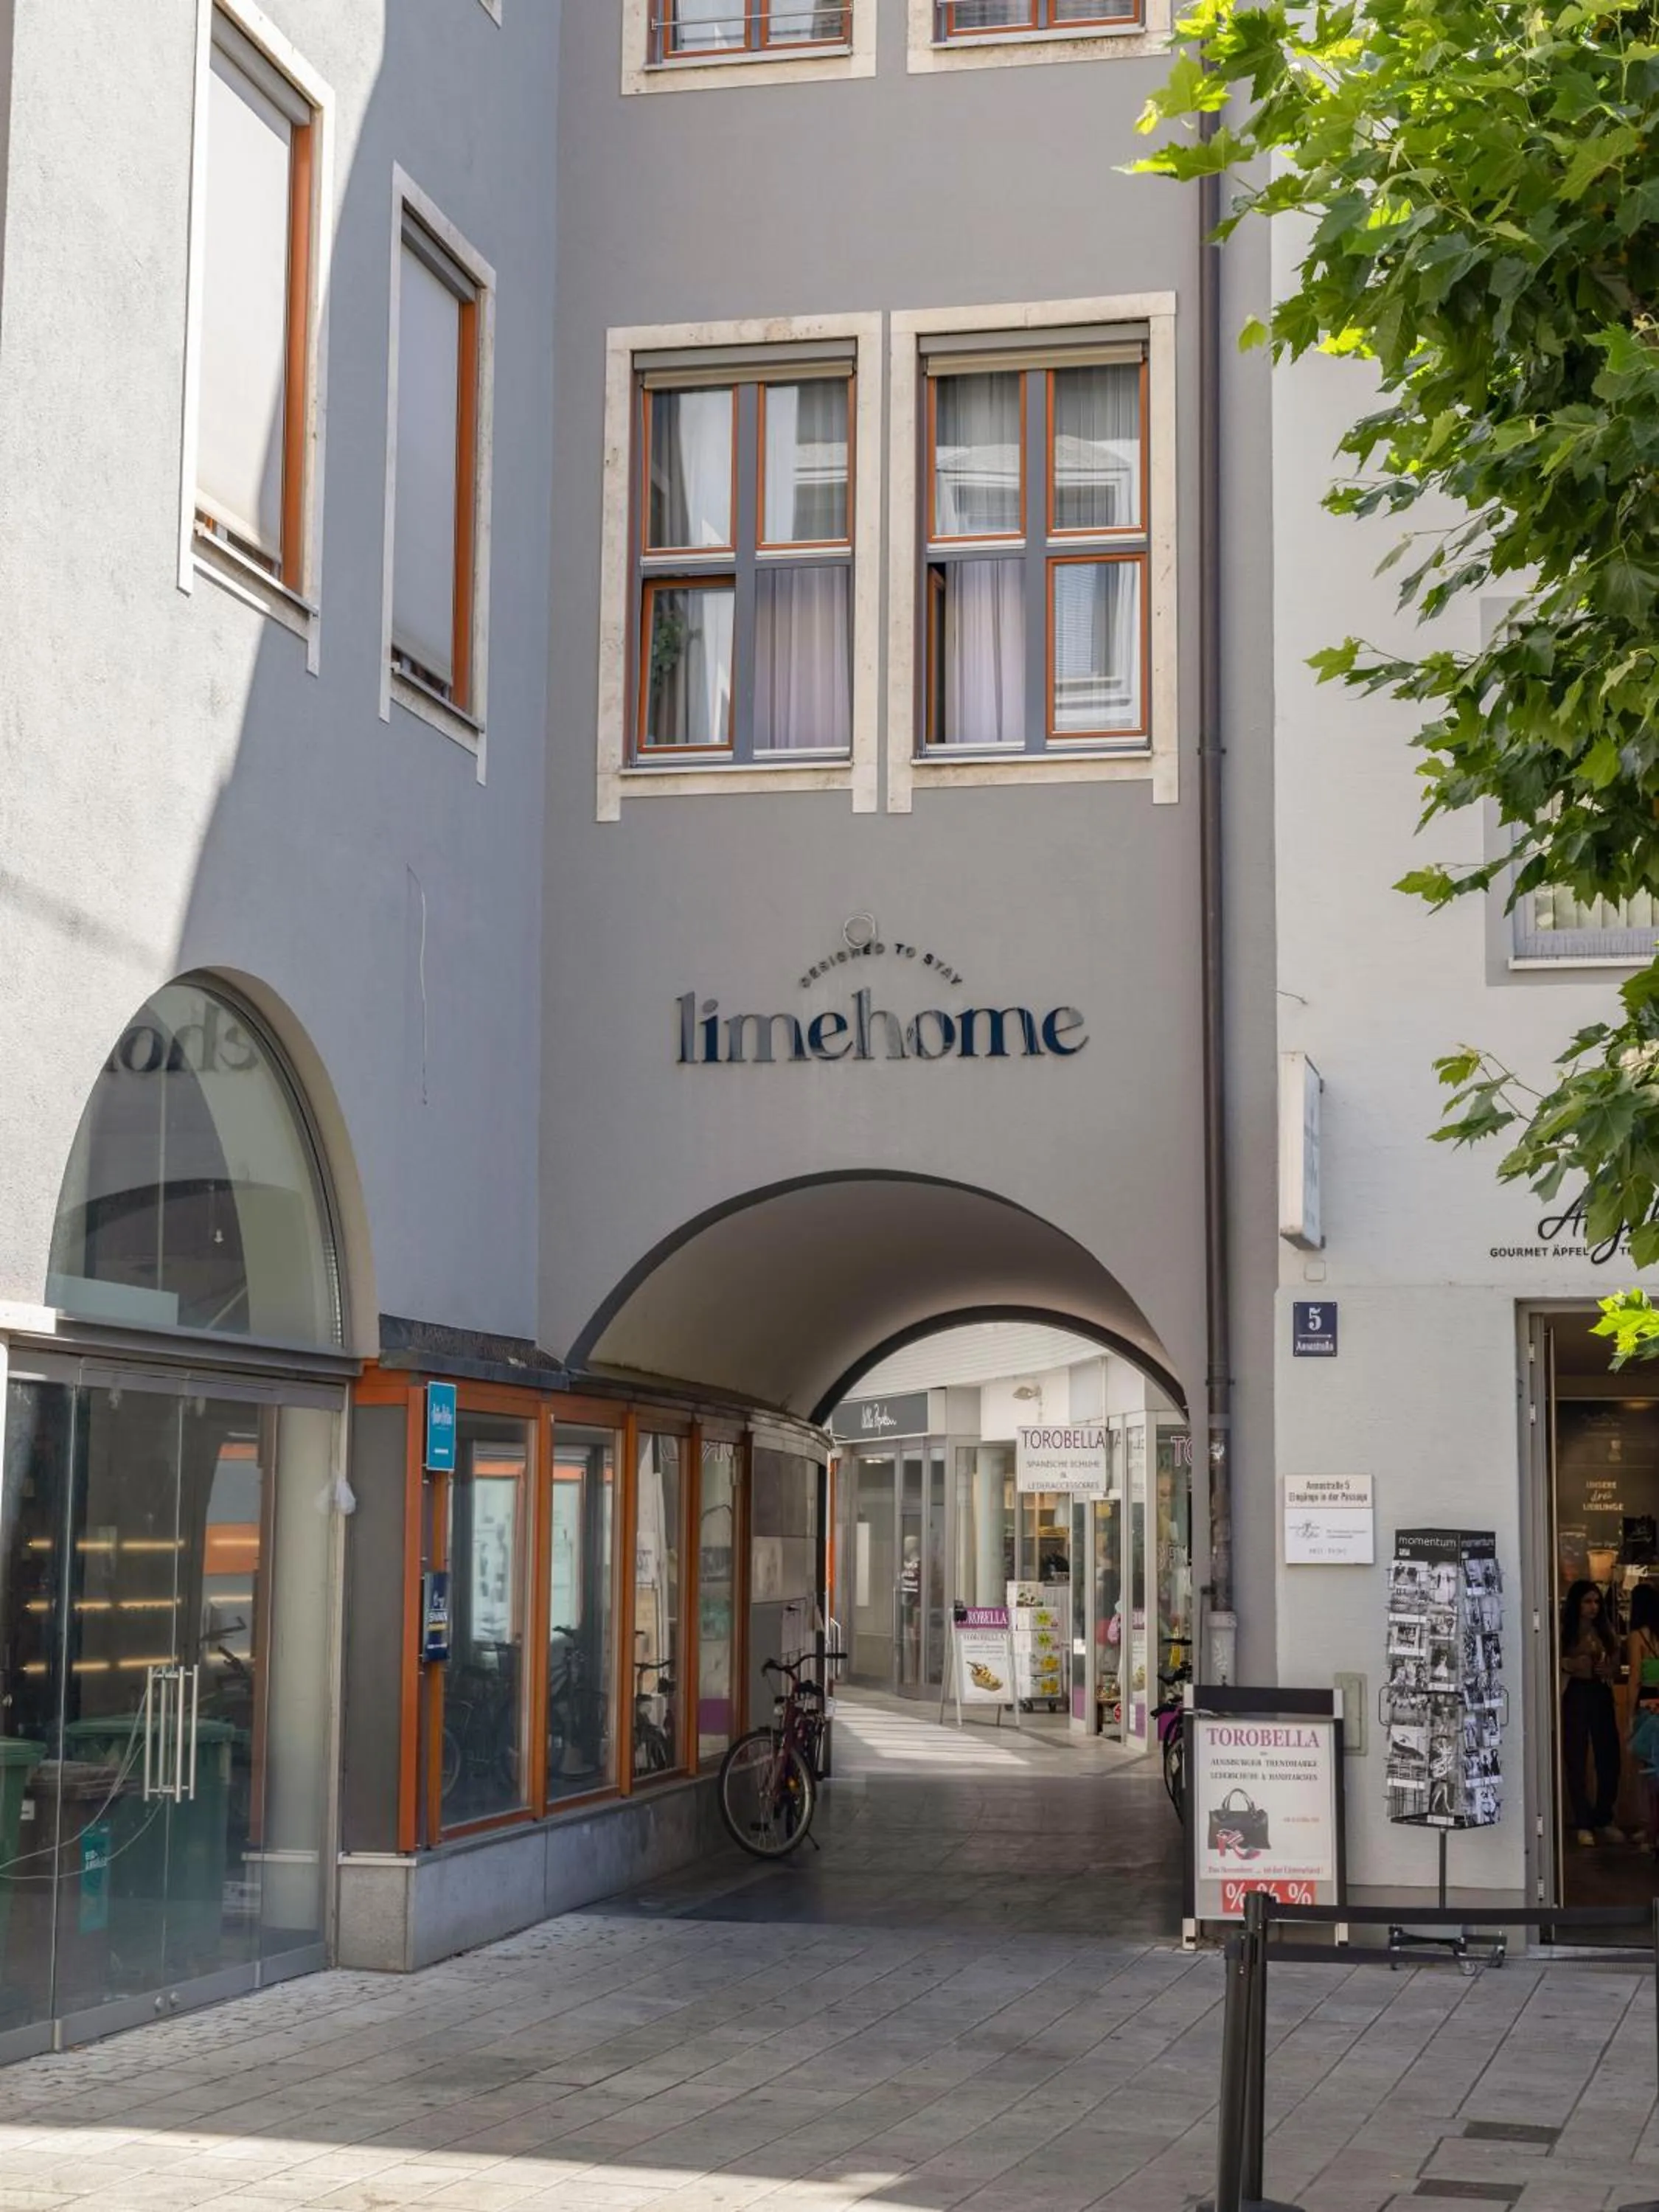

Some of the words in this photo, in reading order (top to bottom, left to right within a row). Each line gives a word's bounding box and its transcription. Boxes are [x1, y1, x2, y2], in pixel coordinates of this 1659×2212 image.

[799, 942, 885, 989] DESIGNED
[895, 942, 917, 959] TO
[923, 951, 962, 987] STAY
[676, 987, 1090, 1064] limehome
[1490, 1247, 1548, 1258] GOURMET
[1552, 1245, 1590, 1257] ÄPFEL
[1309, 1307, 1322, 1331] 5
[1021, 1429, 1105, 1450] TOROBELLA
[1398, 1535, 1456, 1548] momentum
[957, 1610, 1007, 1625] ROBELLA
[1206, 1727, 1320, 1748] TOROBELLA
